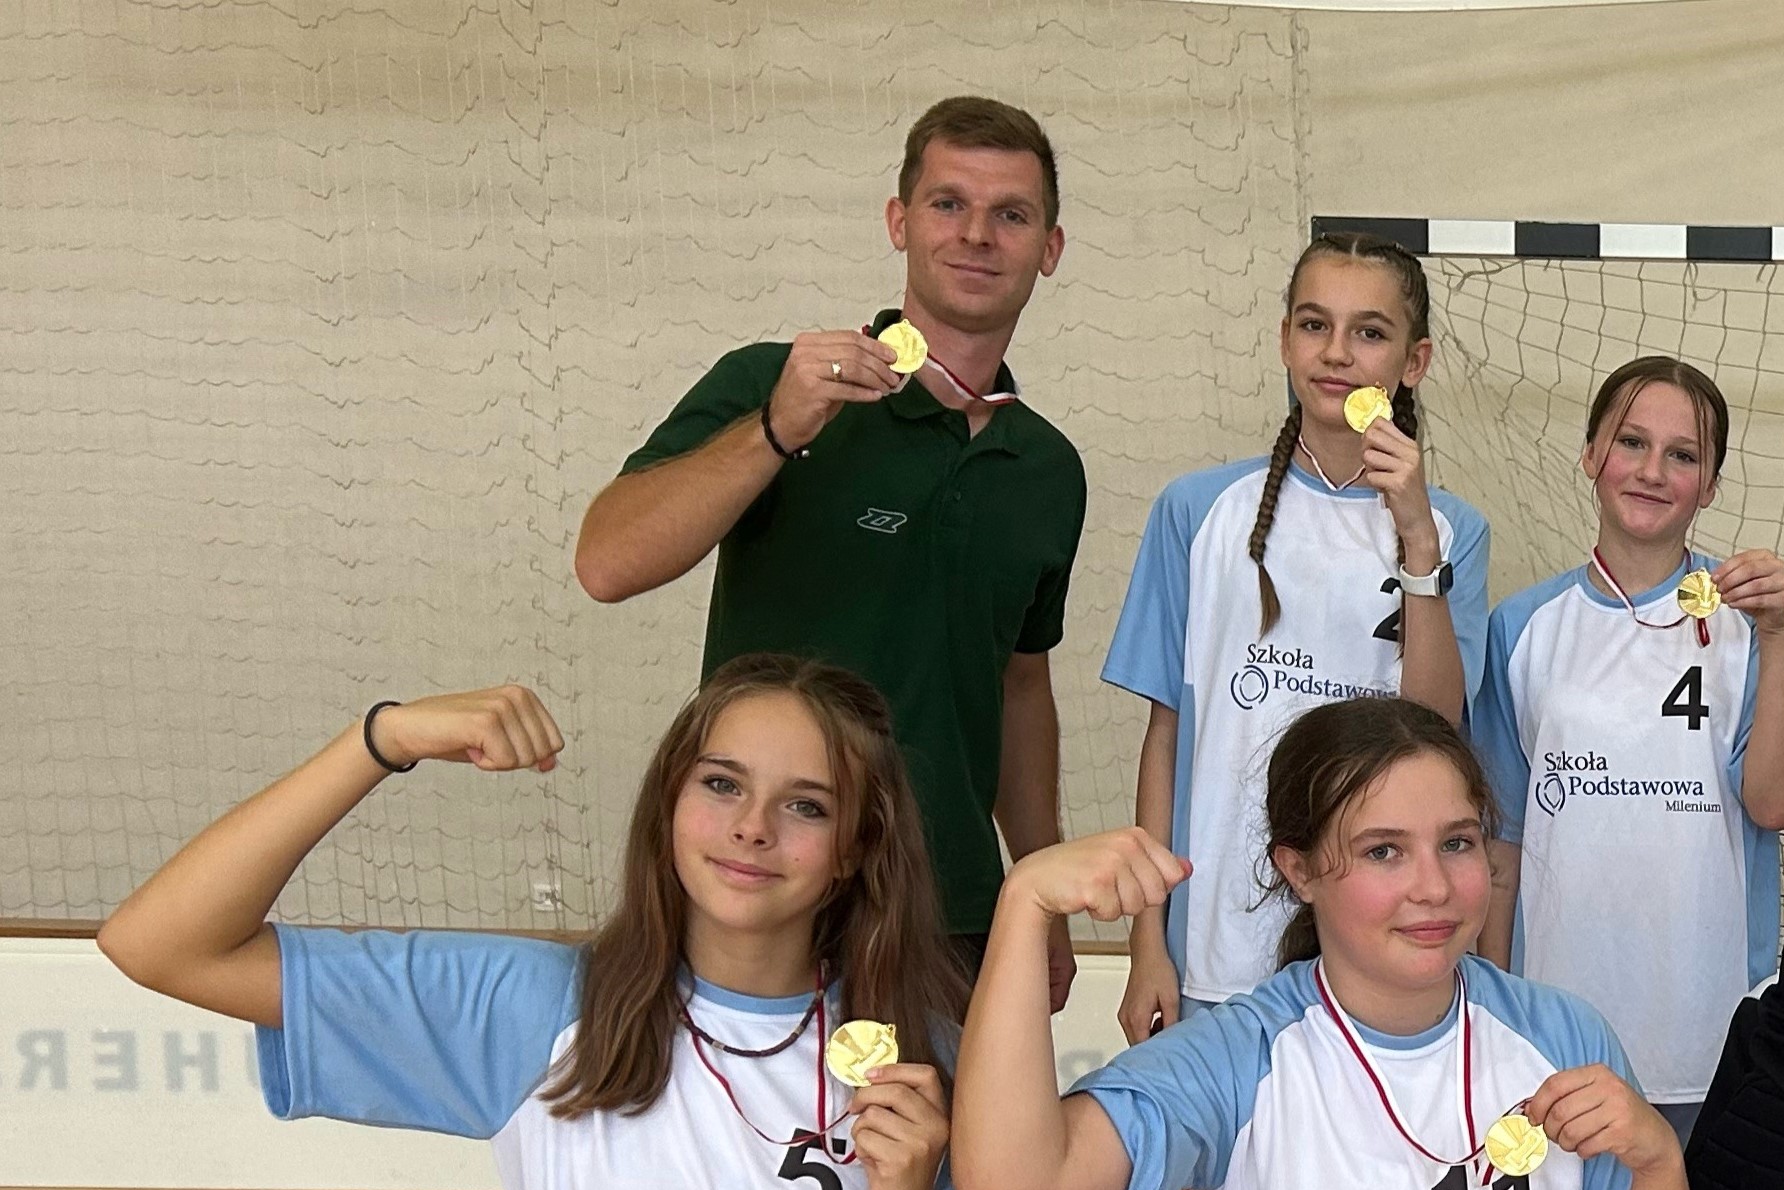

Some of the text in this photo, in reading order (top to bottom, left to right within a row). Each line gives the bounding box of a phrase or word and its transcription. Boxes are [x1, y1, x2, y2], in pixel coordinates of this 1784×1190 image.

[1246, 643, 1314, 670] Szkoła
[1661, 665, 1710, 731] 4
[1544, 751, 1608, 771] Szkoła
[1569, 776, 1705, 796] Podstawowa
[1665, 800, 1722, 813] Milenium
